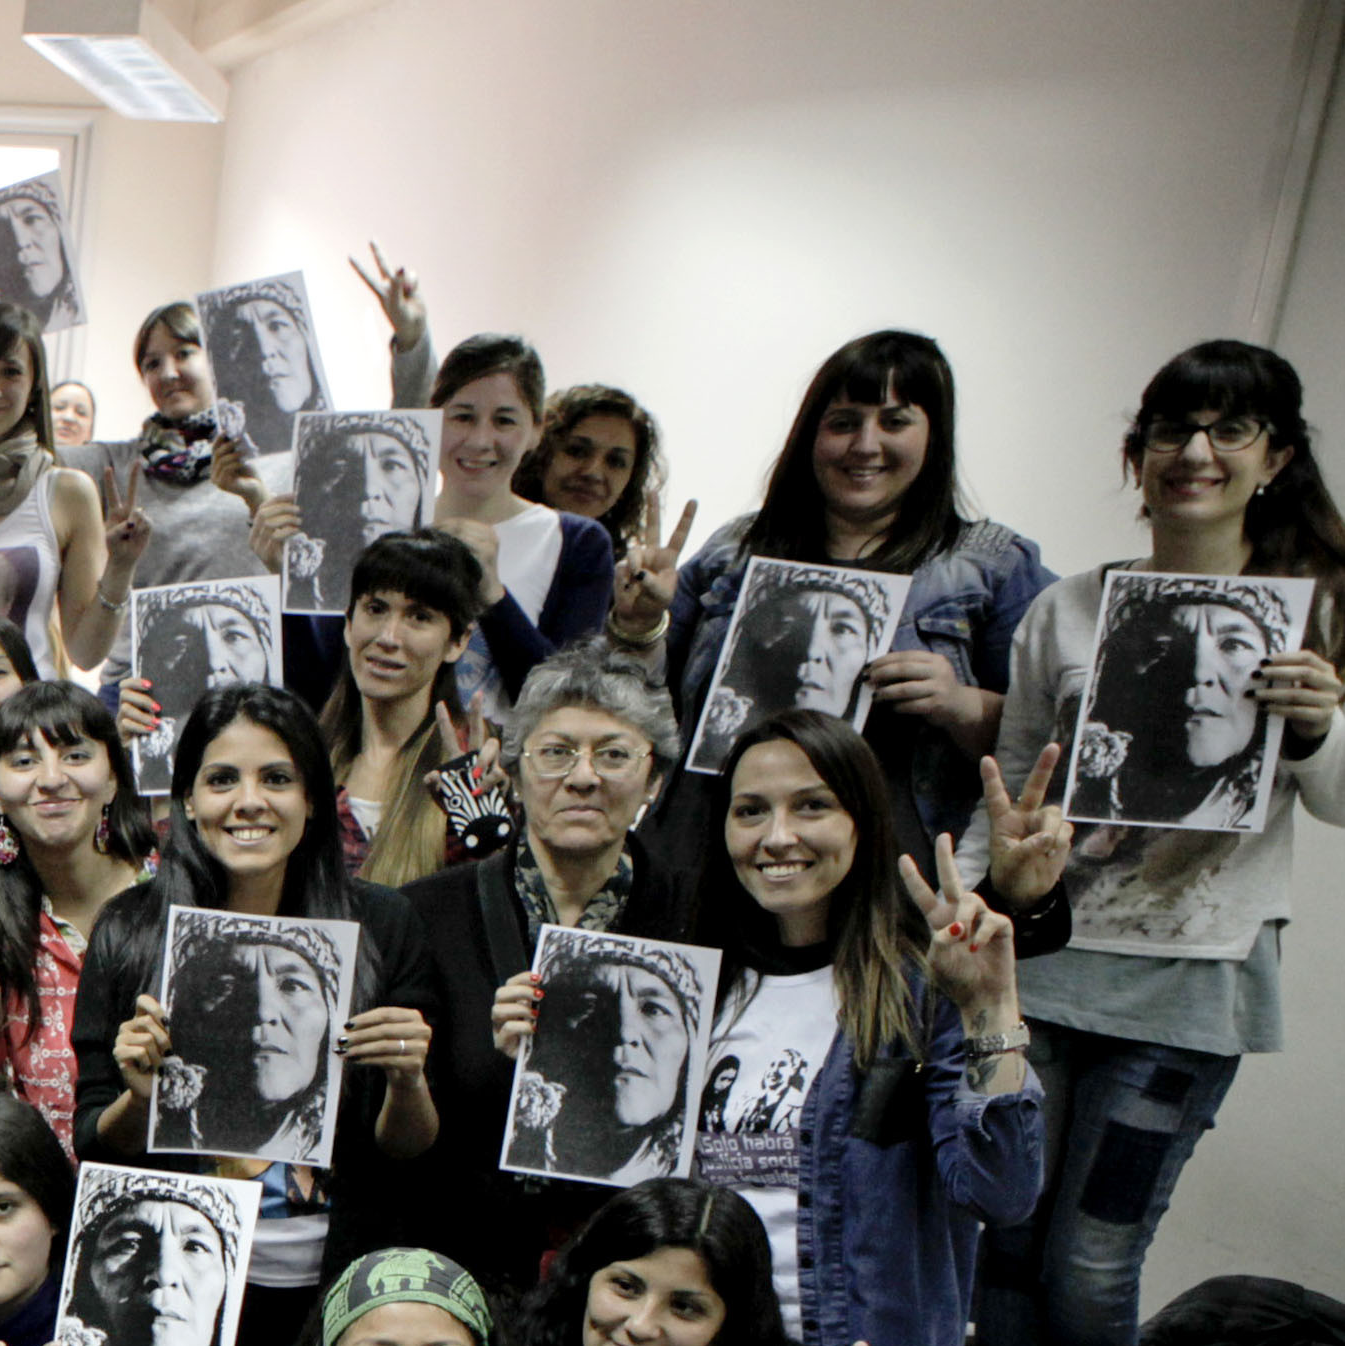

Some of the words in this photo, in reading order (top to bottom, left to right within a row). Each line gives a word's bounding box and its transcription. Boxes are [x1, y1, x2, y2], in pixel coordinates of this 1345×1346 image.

[700, 1135, 739, 1153] Solo
[742, 1130, 795, 1151] habrá
[758, 1151, 800, 1169] socia
